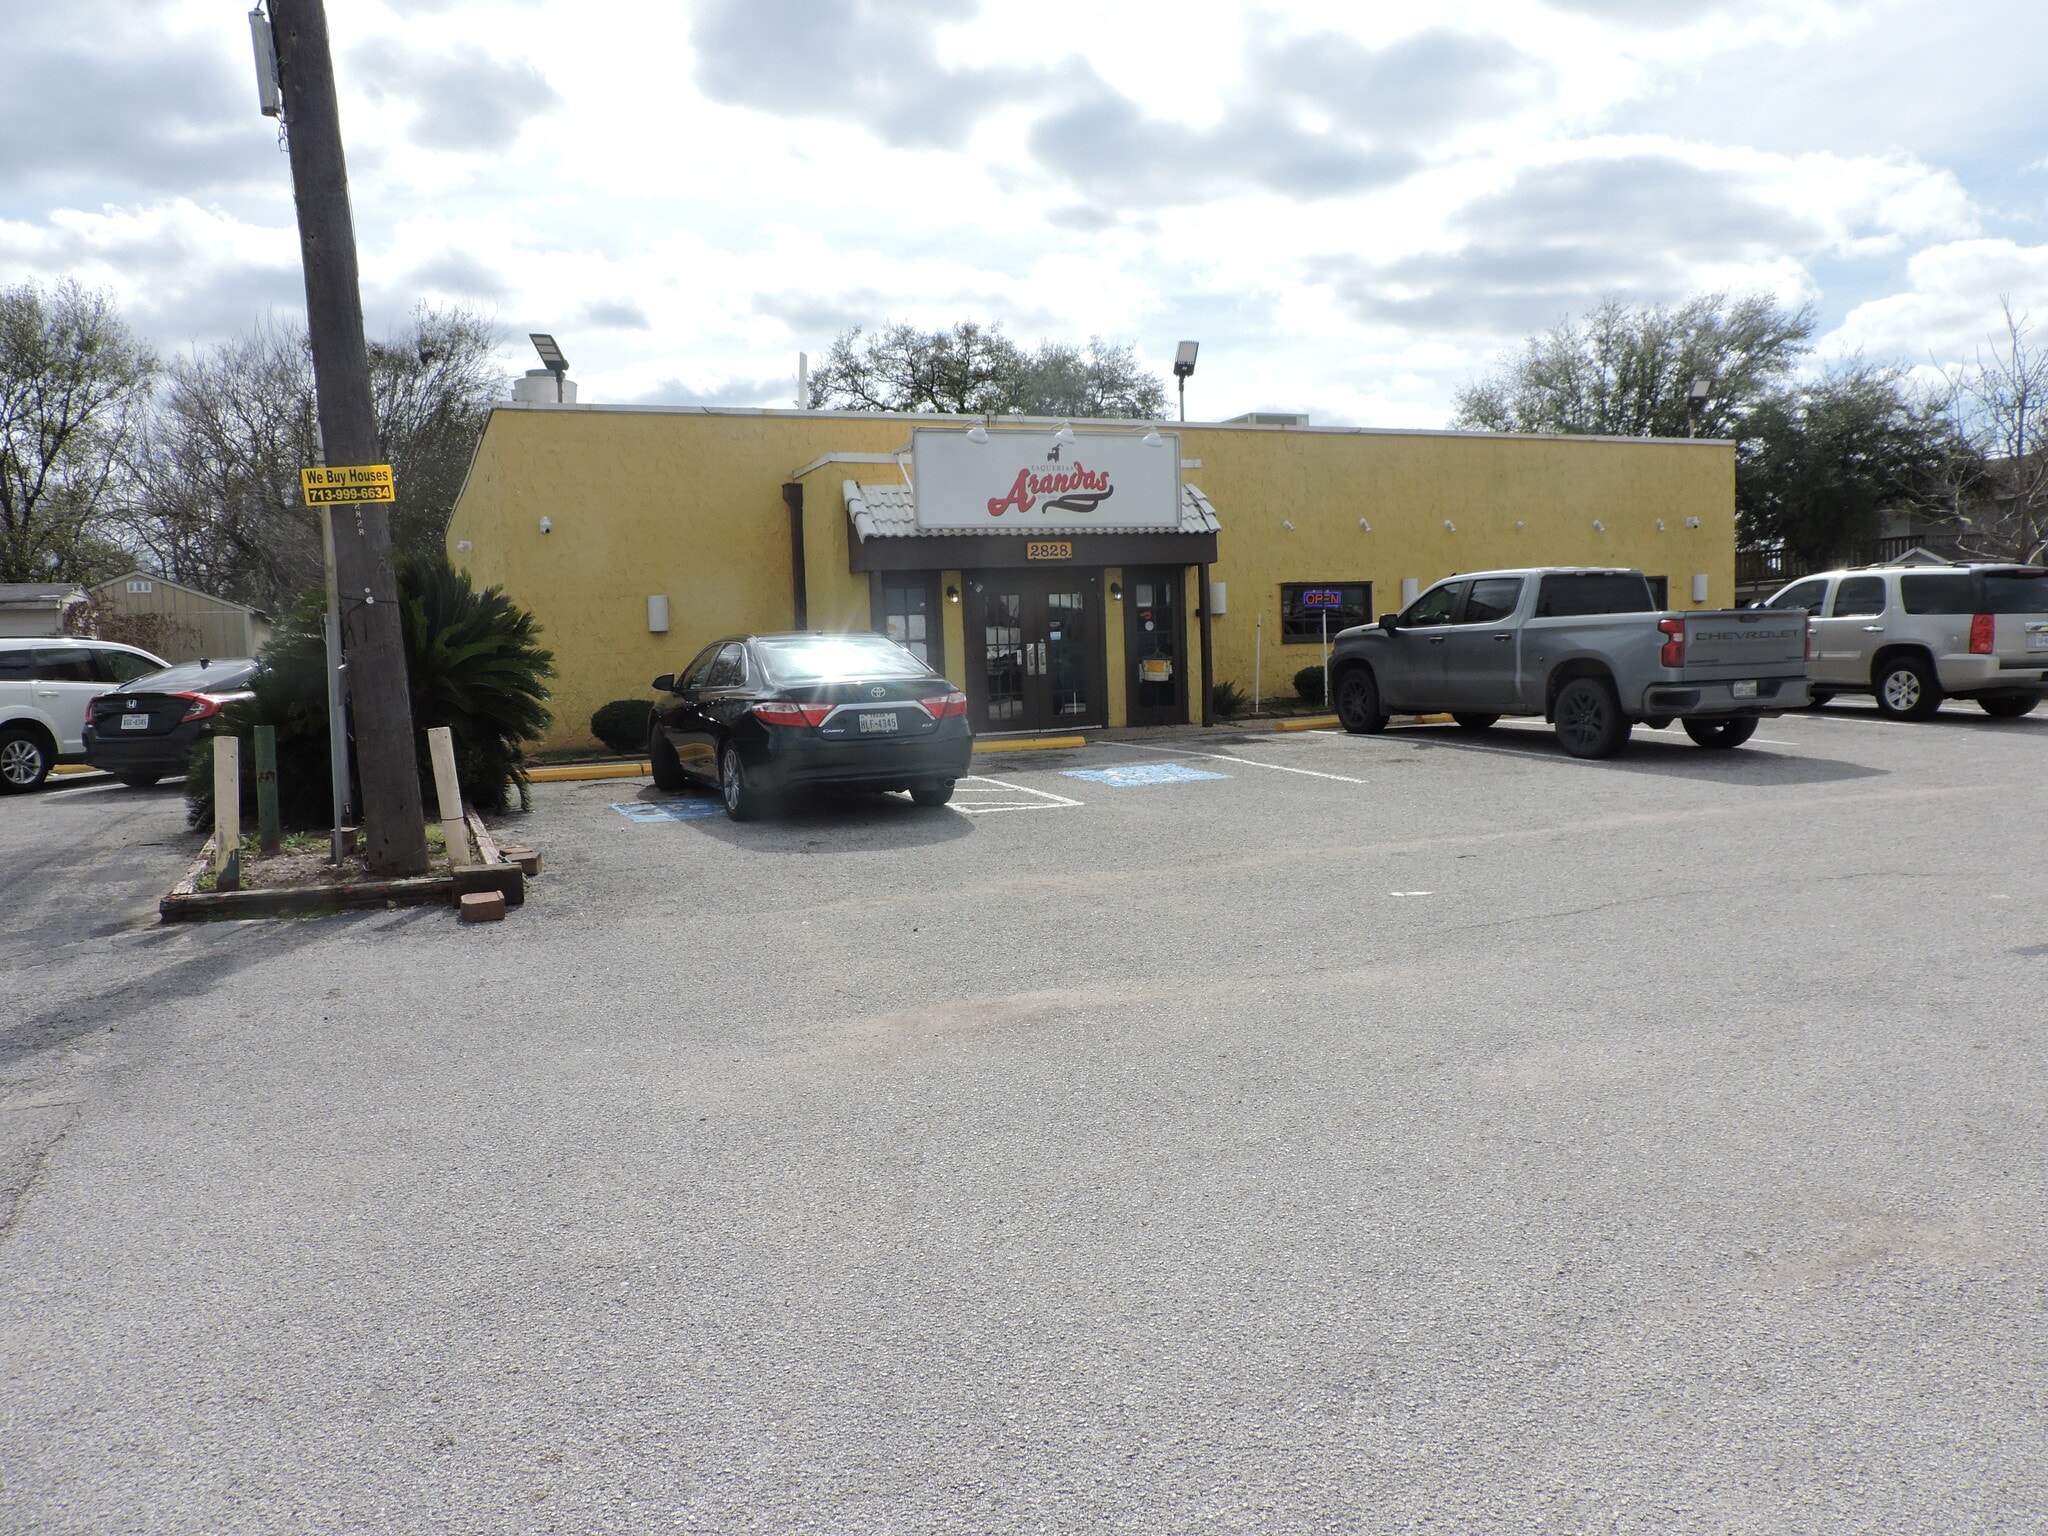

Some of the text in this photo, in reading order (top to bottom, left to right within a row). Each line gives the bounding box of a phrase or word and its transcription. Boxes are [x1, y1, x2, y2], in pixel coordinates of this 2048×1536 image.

[306, 469, 389, 486] We Buy Houses
[309, 487, 390, 501] 713-999-6634
[987, 461, 1110, 517] Arandas
[1030, 544, 1069, 557] 2828
[1306, 593, 1339, 604] OPEN
[1696, 629, 1800, 641] CHEVROLET
